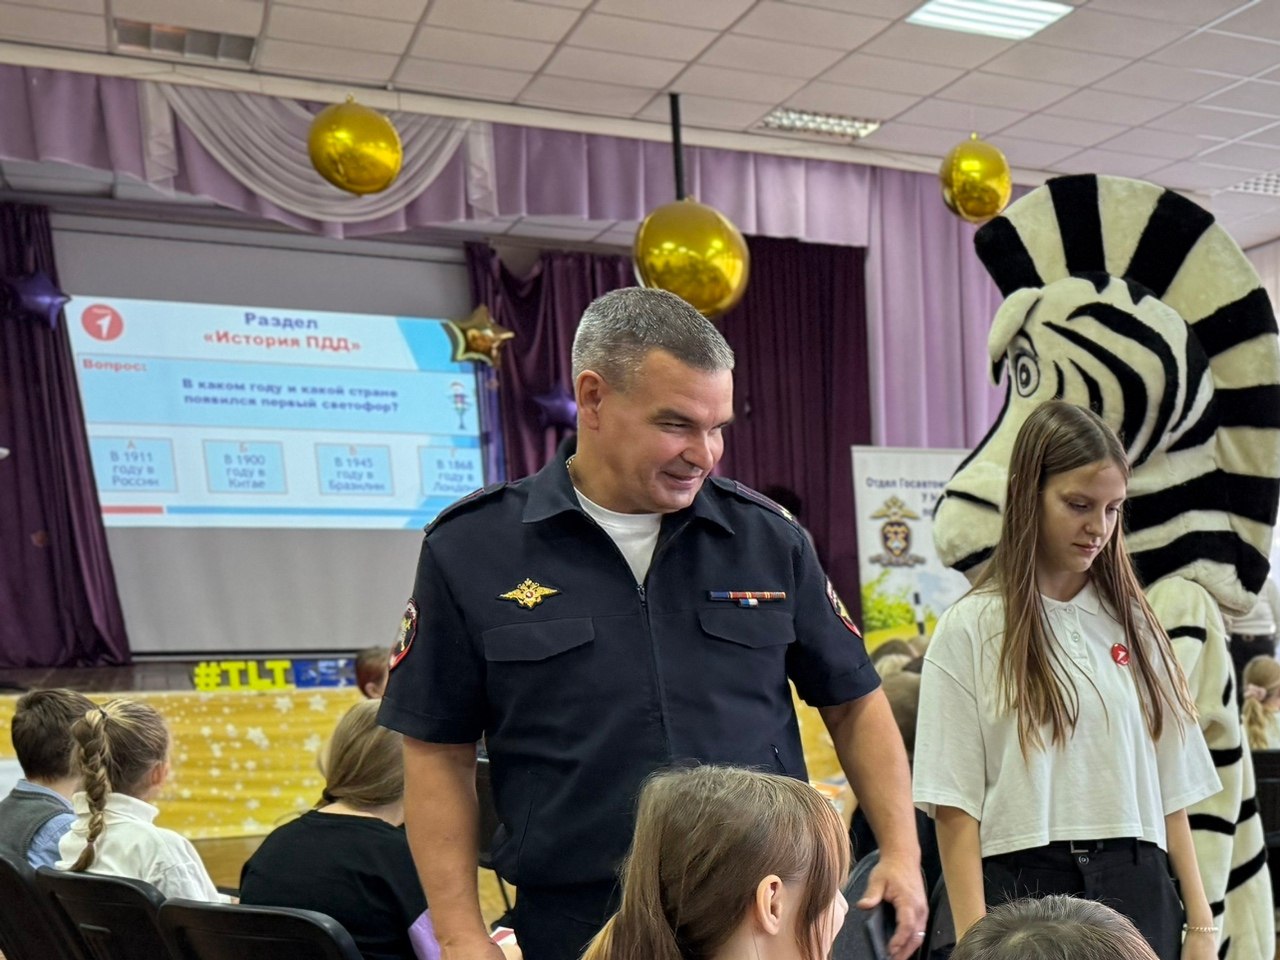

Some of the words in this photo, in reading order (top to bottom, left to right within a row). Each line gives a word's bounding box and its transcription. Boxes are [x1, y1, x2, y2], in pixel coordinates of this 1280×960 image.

[245, 312, 319, 331] Раздел
[203, 330, 300, 349] «История
[305, 335, 361, 353] ПДД»
[83, 358, 147, 372] Вопрос:
[182, 378, 193, 389] В
[198, 380, 246, 392] каком
[250, 383, 282, 395] году
[287, 385, 297, 394] и
[301, 384, 345, 396] какой
[348, 387, 398, 398] стране
[184, 394, 256, 406] появился
[261, 397, 317, 409] первый
[322, 399, 399, 413] светофор?
[110, 451, 119, 462] В
[124, 451, 153, 463] 1911
[237, 454, 266, 465] 1900
[112, 464, 143, 475] году
